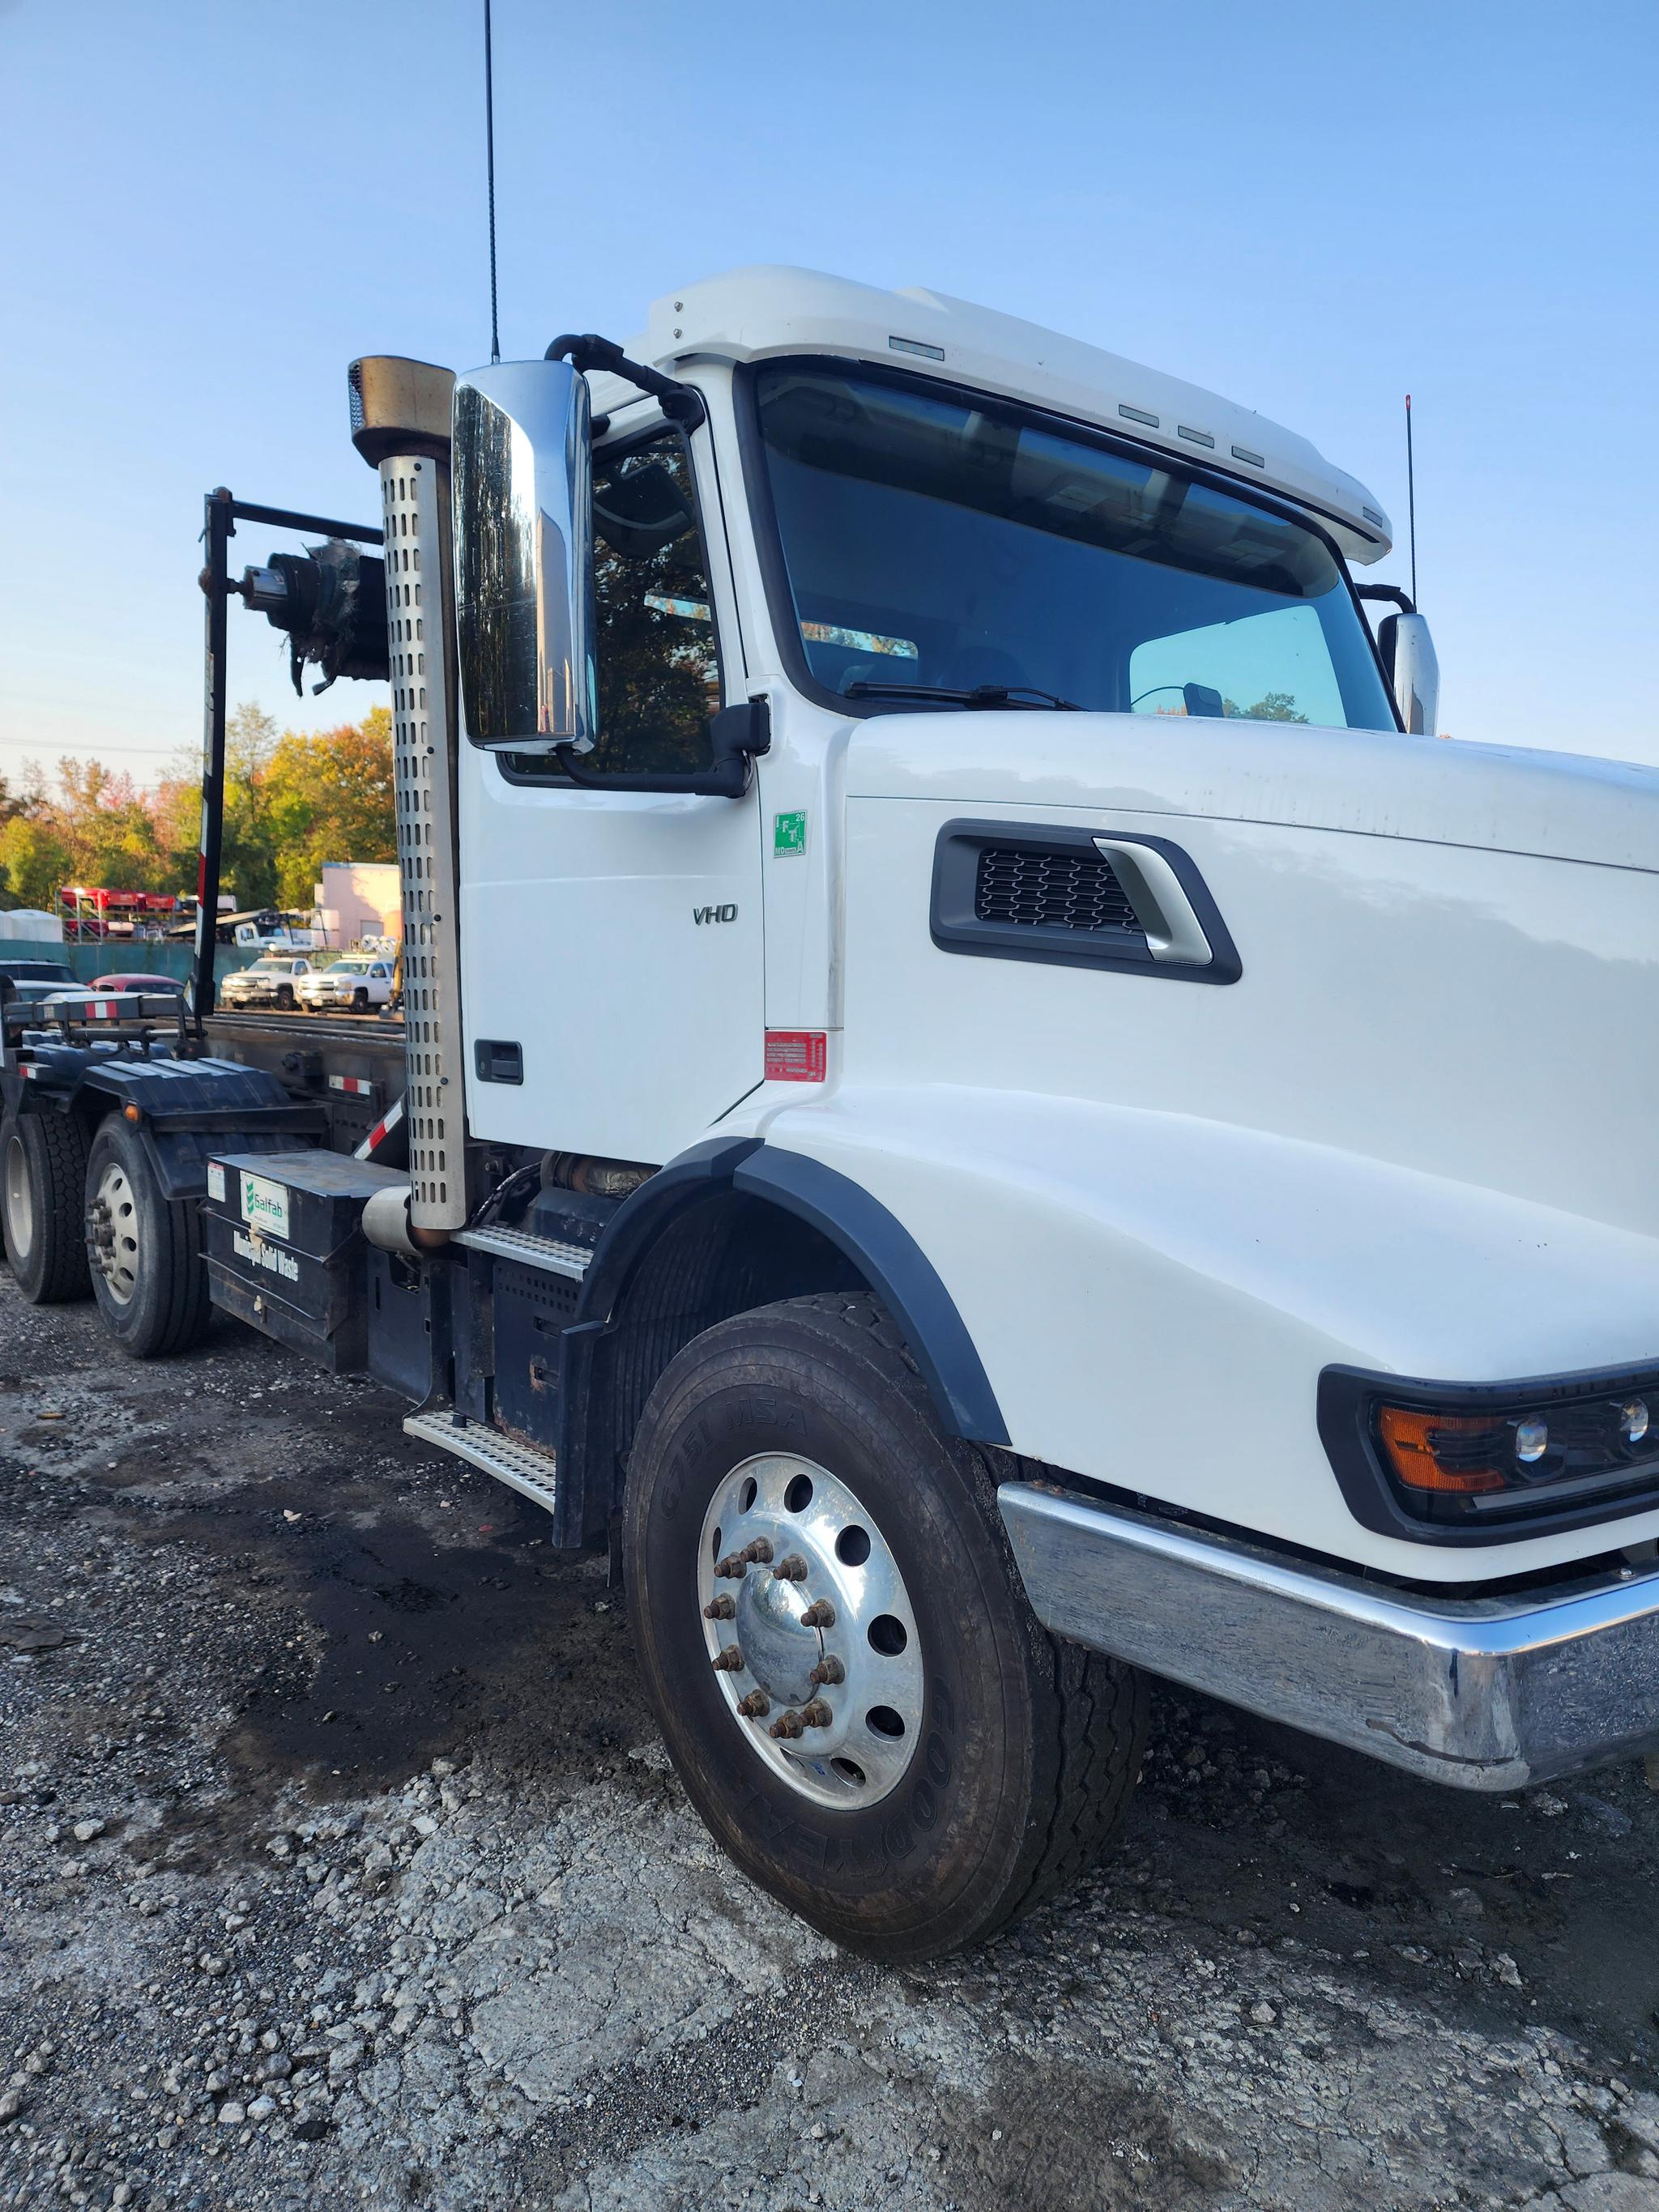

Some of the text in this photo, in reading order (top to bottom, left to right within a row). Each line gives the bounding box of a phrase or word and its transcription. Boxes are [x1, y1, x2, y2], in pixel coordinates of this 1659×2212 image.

[795, 812, 805, 822] 26
[693, 903, 739, 926] VHD
[254, 1193, 283, 1217] Galfab
[724, 1396, 808, 1437] MSA
